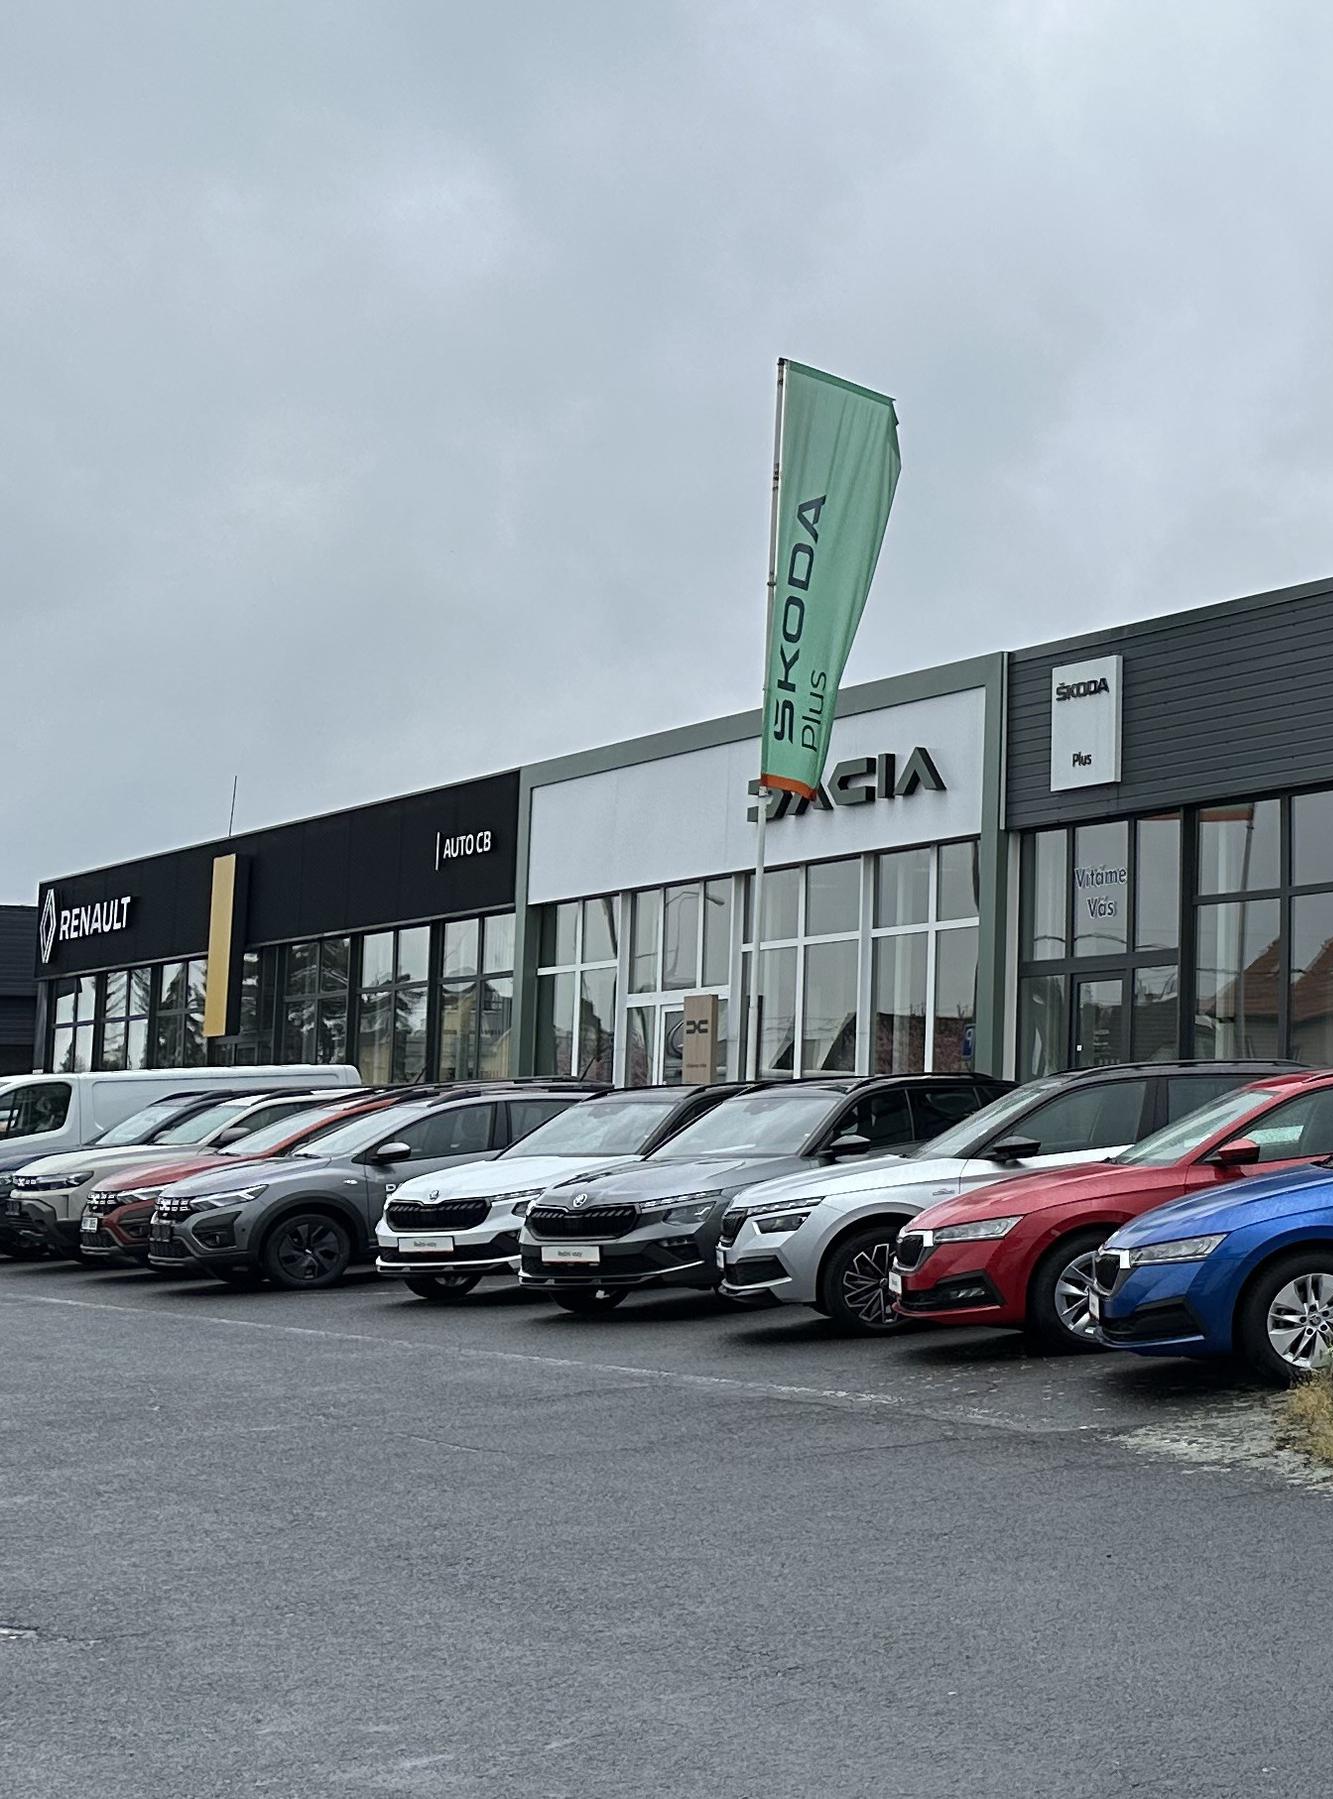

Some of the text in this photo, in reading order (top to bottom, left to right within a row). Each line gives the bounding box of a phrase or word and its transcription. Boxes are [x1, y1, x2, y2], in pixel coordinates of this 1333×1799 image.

[773, 494, 828, 745] ŠKODA
[1056, 677, 1110, 702] ŠKODA
[1072, 751, 1092, 768] Plus
[443, 830, 491, 859] AUTO CB
[59, 896, 131, 941] RENAULT
